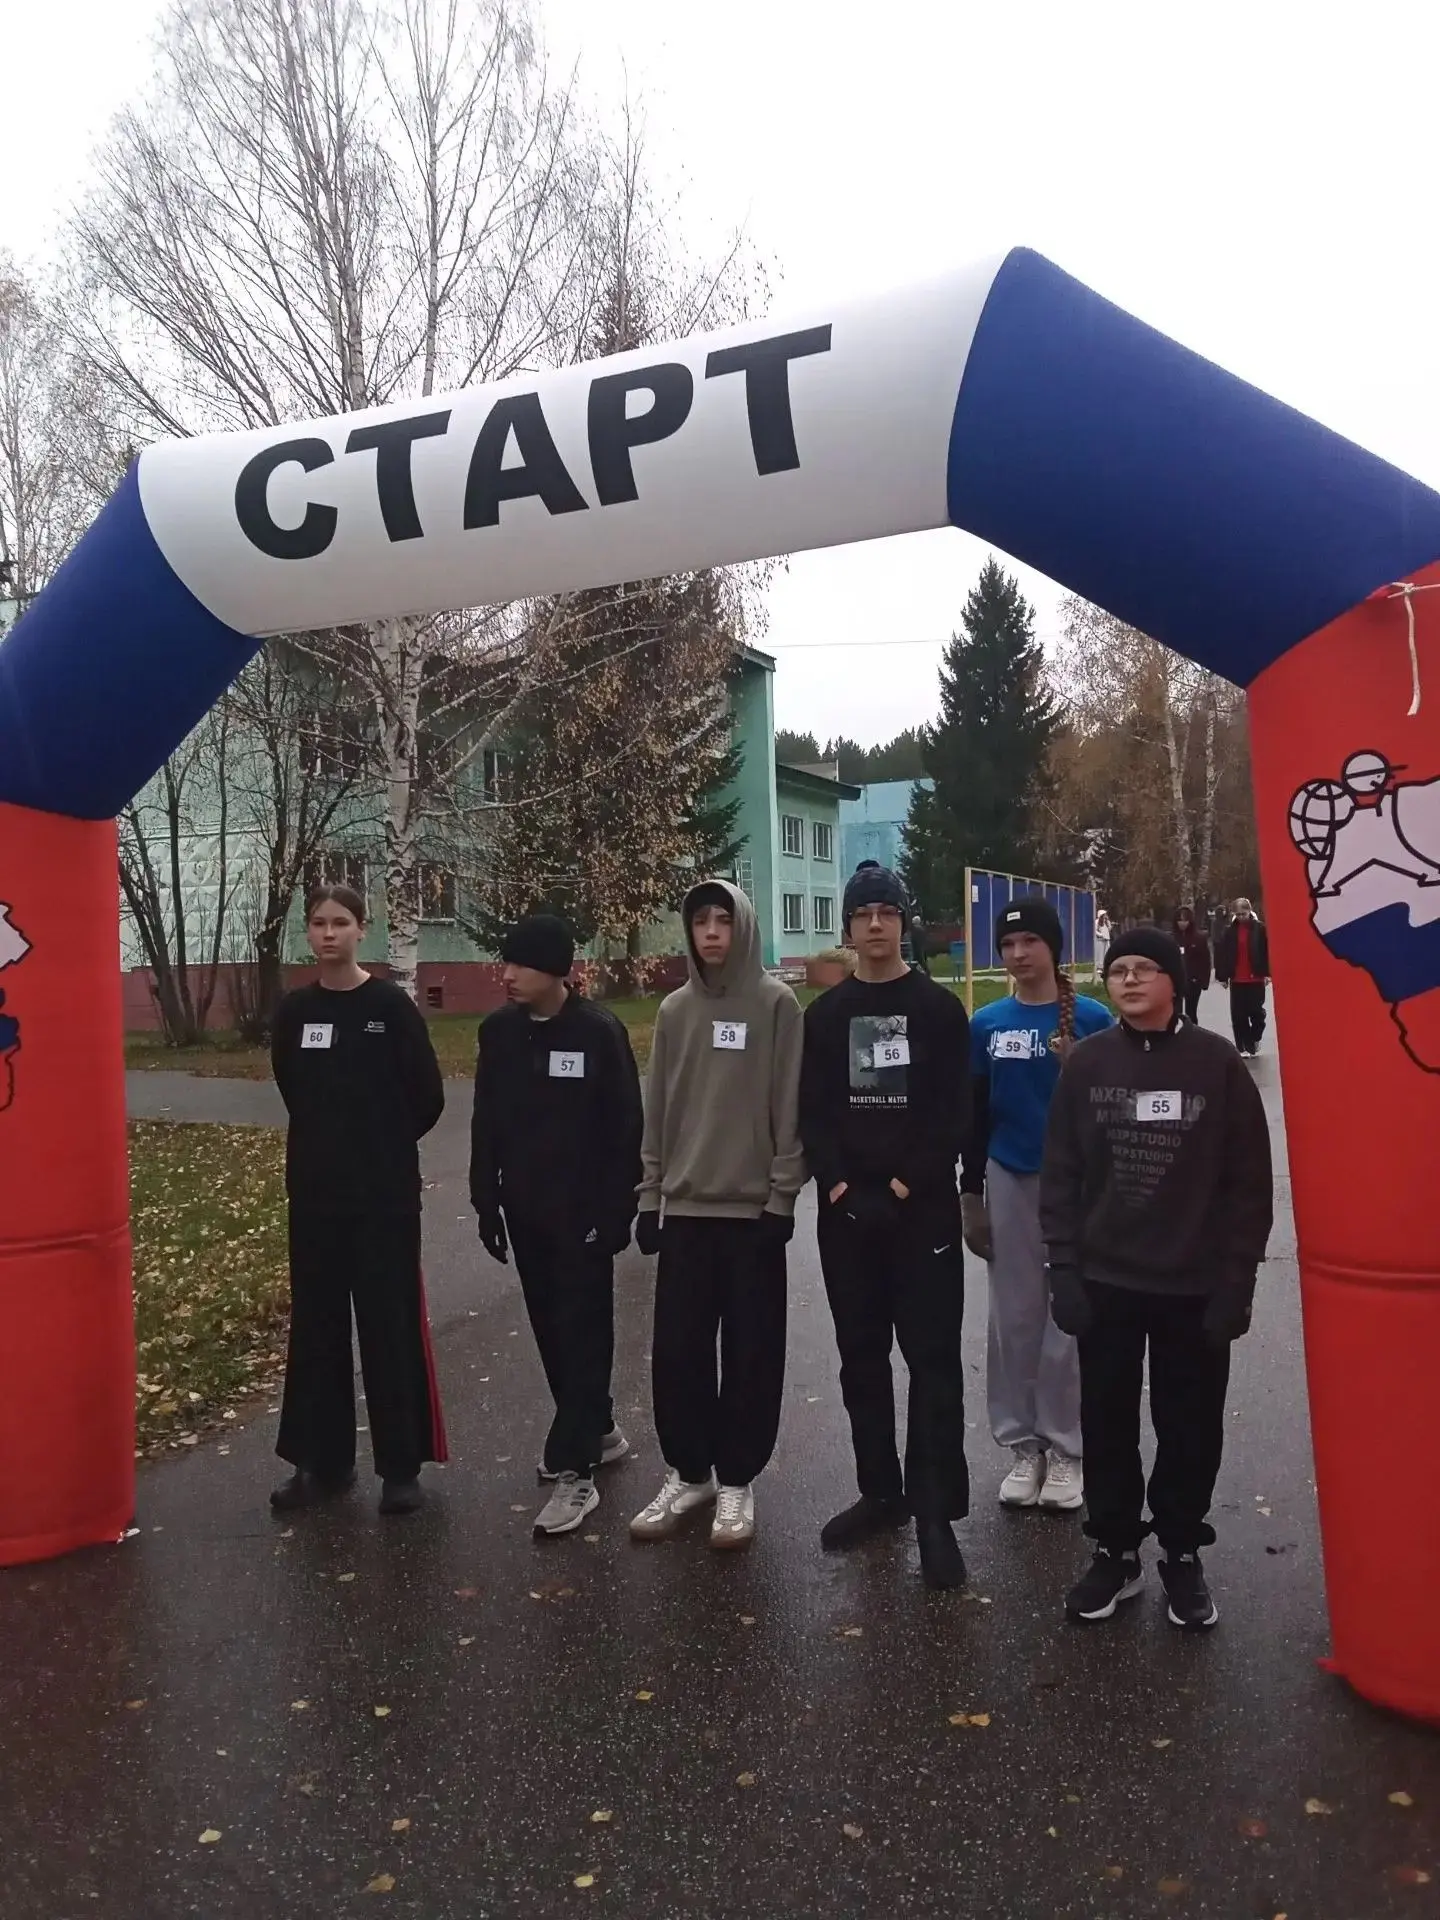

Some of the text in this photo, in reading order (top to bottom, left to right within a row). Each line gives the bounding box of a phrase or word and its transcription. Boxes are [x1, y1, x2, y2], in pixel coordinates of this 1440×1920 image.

[235, 323, 832, 560] СТАРТ
[310, 1031, 324, 1042] 60
[720, 1030, 736, 1042] 58
[1005, 1041, 1021, 1052] 59
[884, 1048, 900, 1061] 56
[560, 1060, 575, 1071] 57
[849, 1095, 908, 1104] BASKETBALL MATCH
[1151, 1100, 1171, 1113] 55
